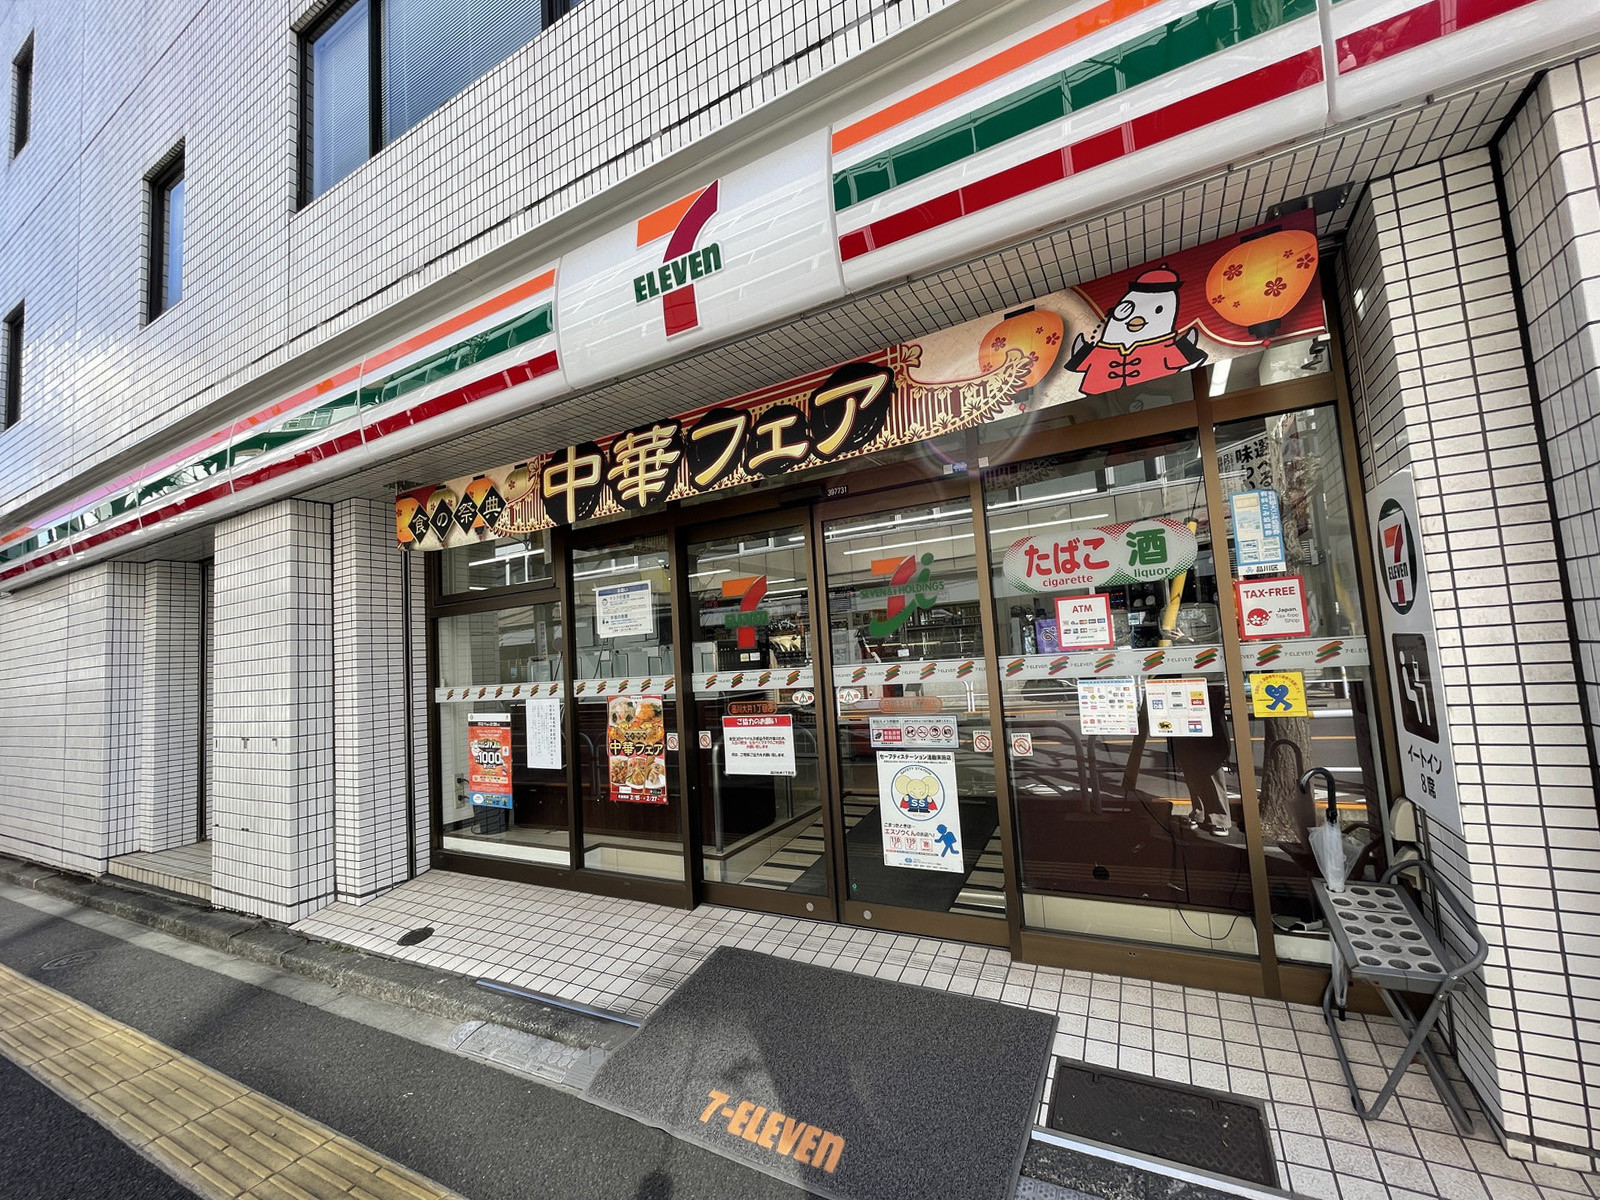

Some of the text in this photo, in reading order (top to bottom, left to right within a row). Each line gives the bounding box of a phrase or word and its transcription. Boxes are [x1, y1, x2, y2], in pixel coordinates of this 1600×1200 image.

[543, 373, 889, 524] 中華フェア
[411, 494, 503, 536] 食の祭典
[1024, 528, 1168, 578] たばこ 酒
[899, 580, 945, 594] HOLDINGS
[1042, 566, 1171, 588] cigarette liquor
[1243, 585, 1296, 600] TAX-FREE
[1072, 603, 1093, 614] ATM
[609, 739, 664, 756] 中華フェア
[1407, 744, 1442, 776] イートイン
[1420, 773, 1437, 799] 8席
